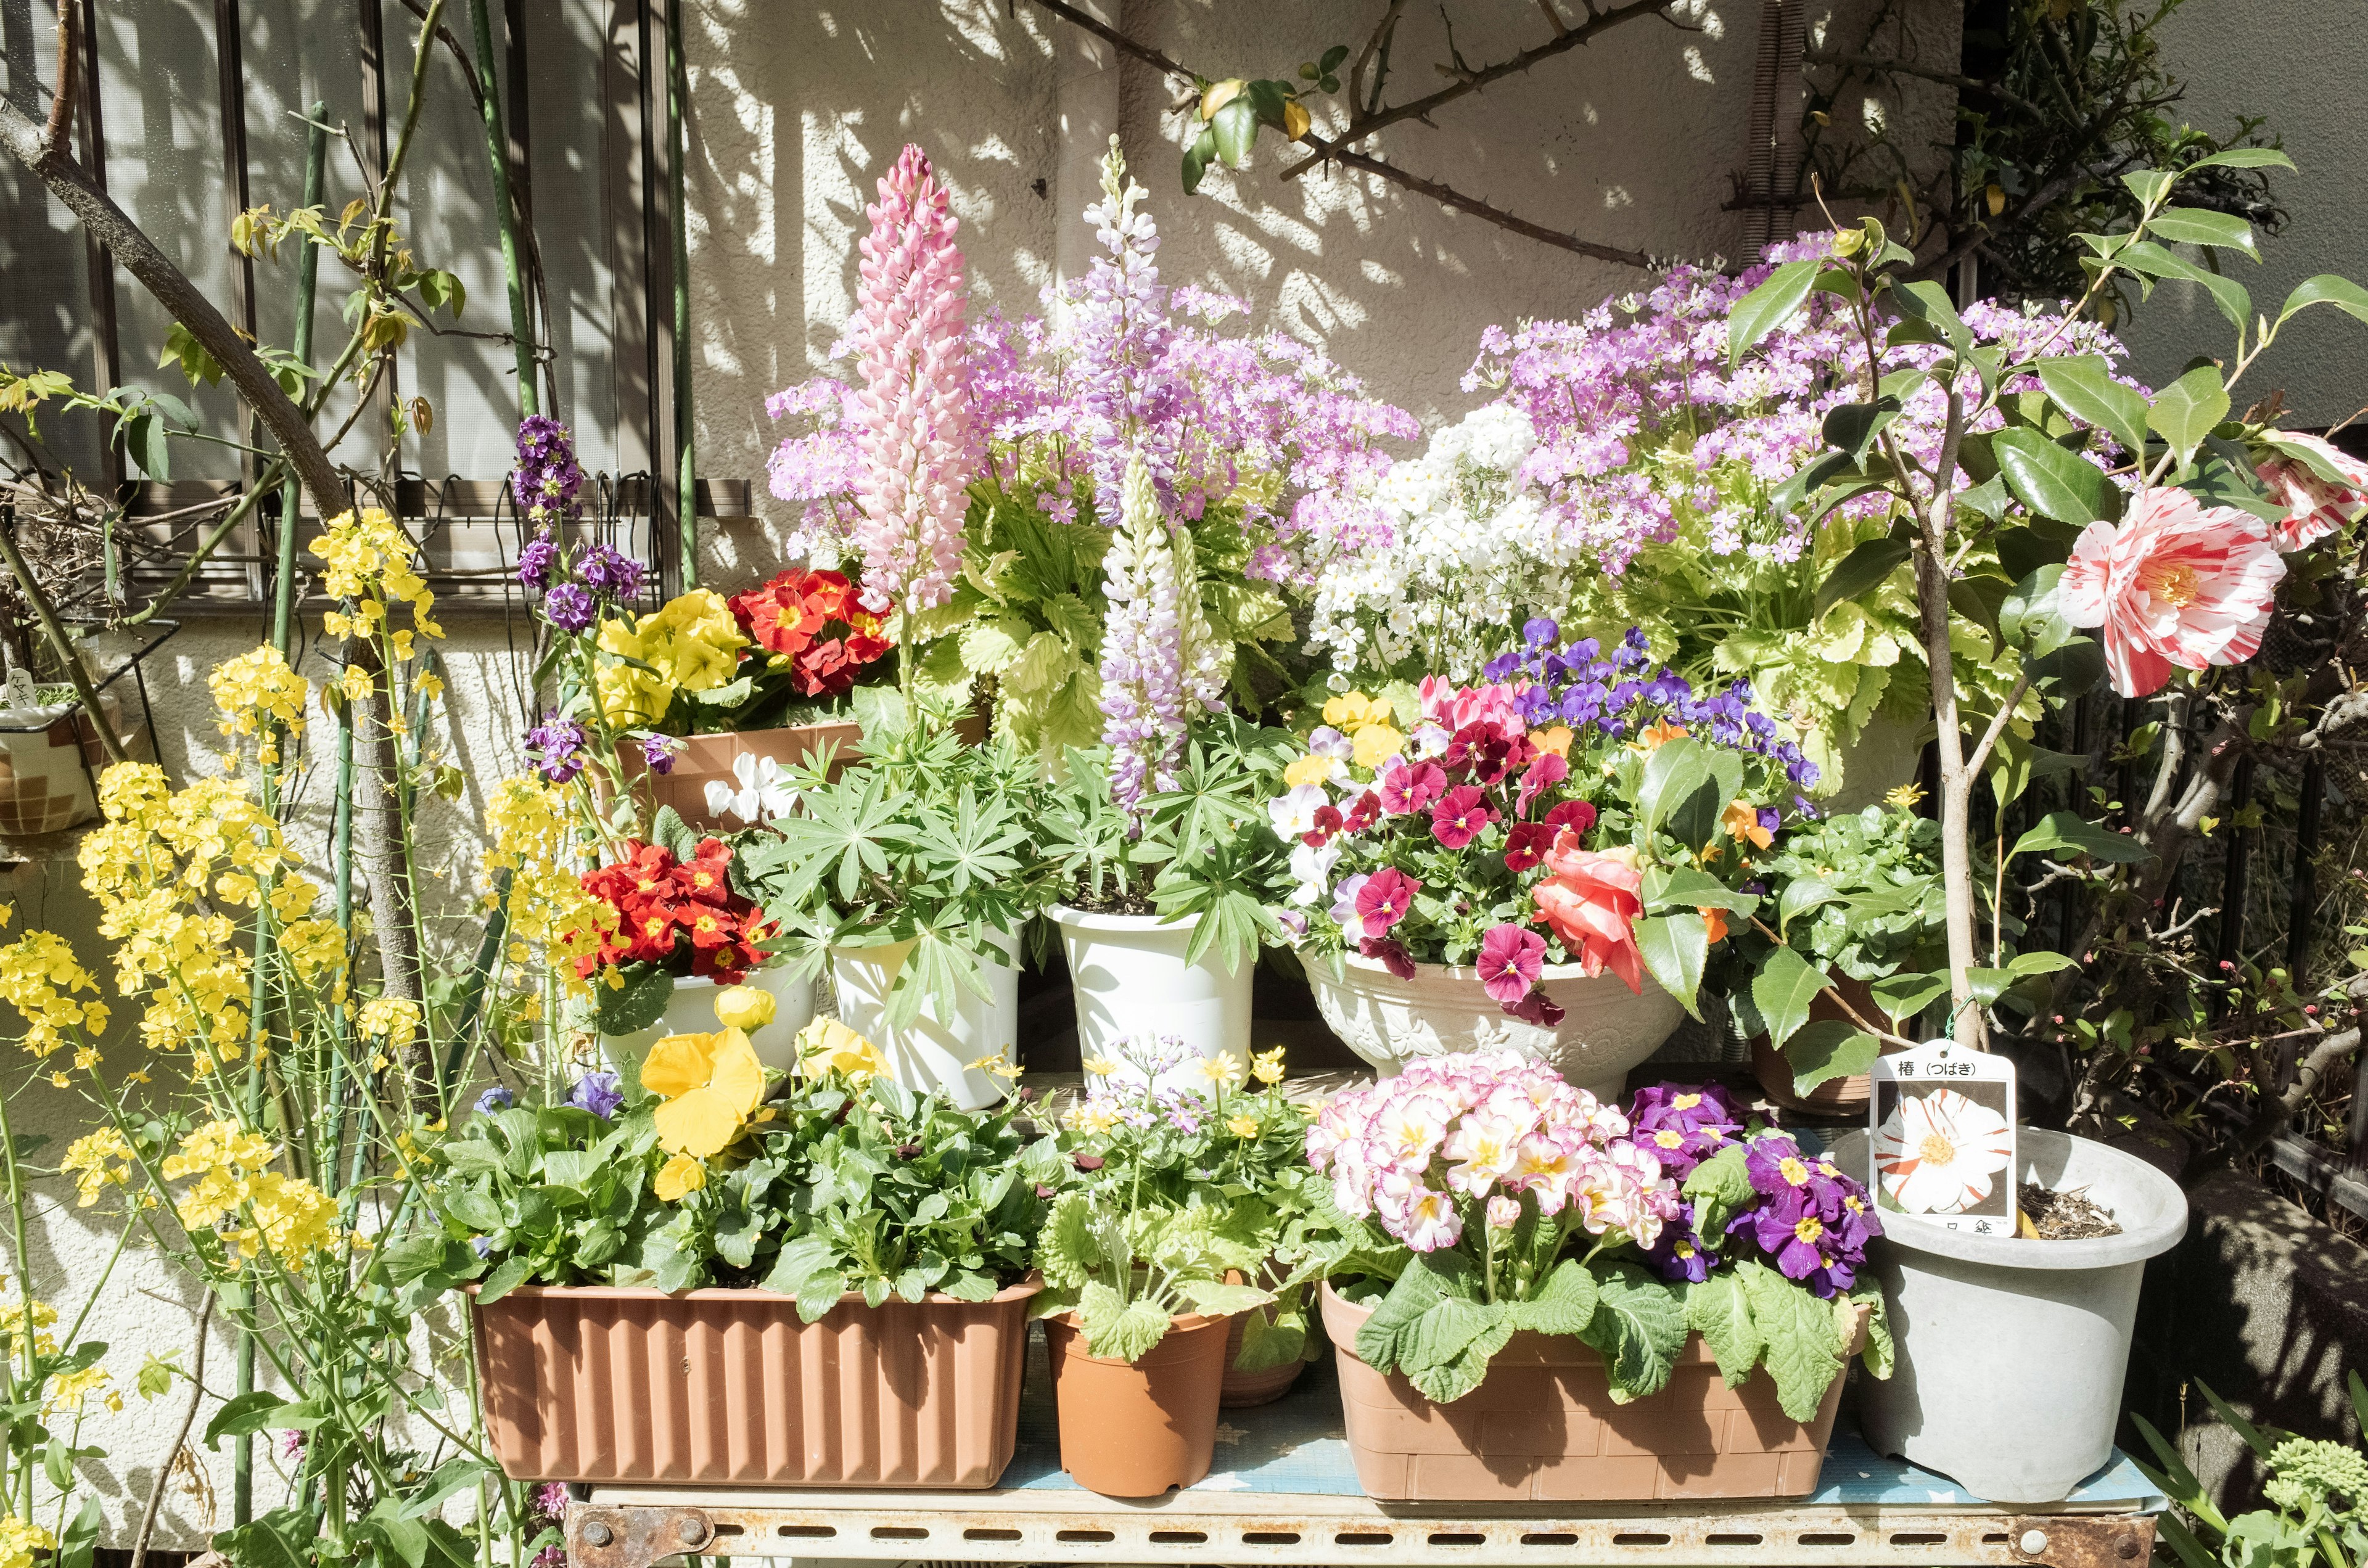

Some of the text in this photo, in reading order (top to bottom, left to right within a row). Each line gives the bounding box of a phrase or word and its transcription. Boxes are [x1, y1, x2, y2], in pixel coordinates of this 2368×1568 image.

[10, 674, 29, 705] ケヤキ
[1897, 1061, 1914, 1077] 椿
